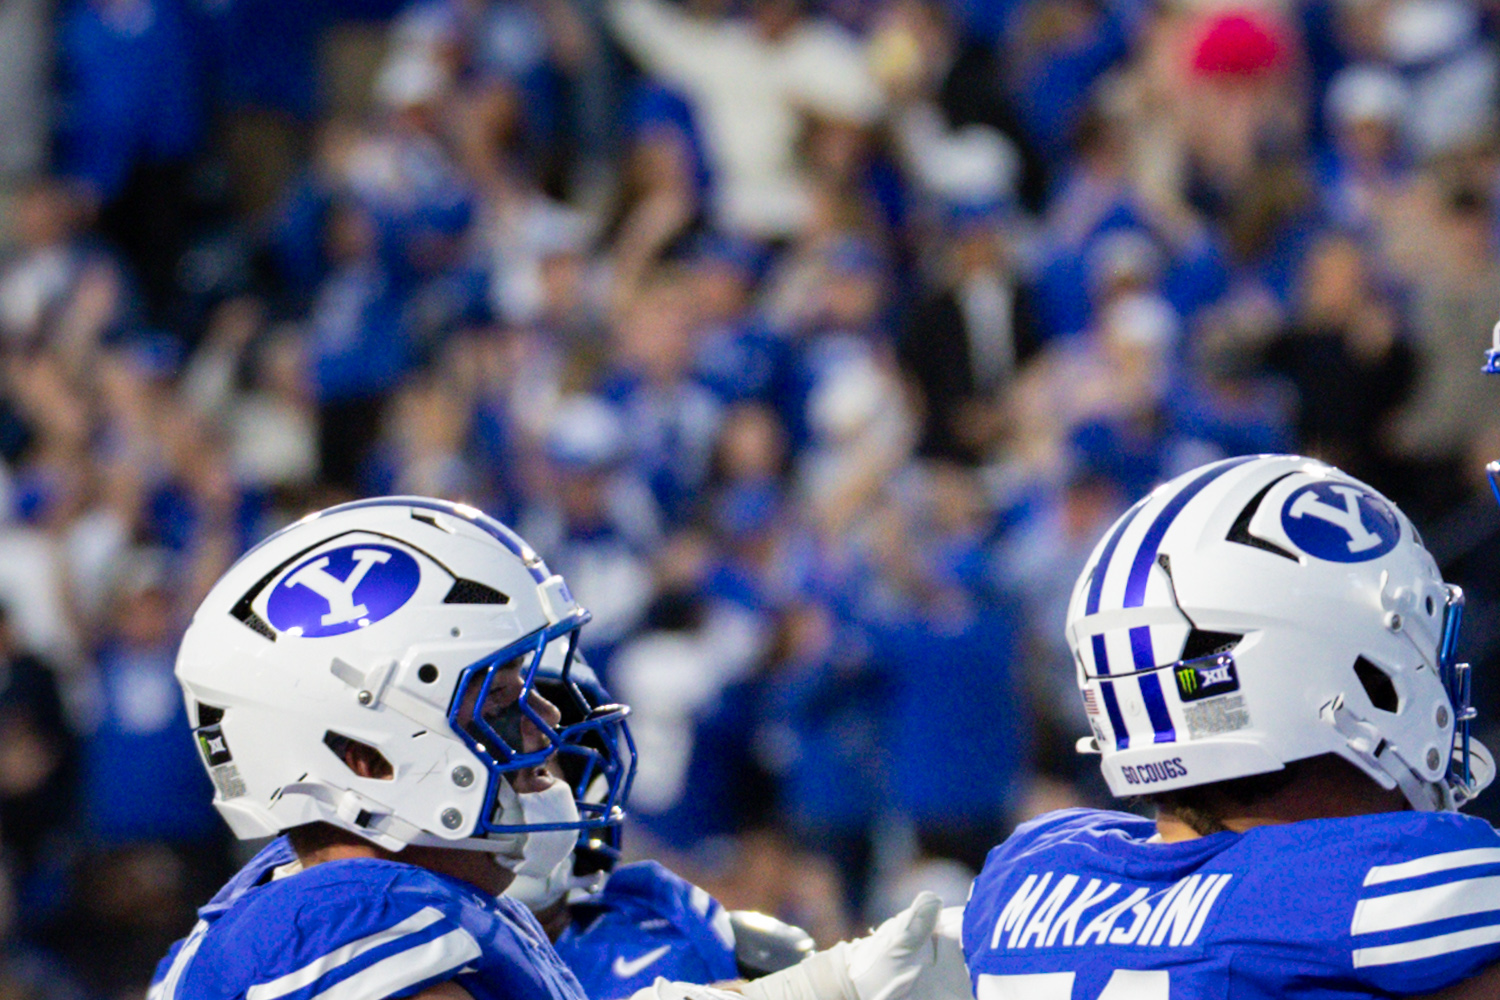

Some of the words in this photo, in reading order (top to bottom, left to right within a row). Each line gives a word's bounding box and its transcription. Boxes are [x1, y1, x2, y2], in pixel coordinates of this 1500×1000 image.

[1289, 485, 1383, 553] Y
[285, 549, 391, 626] Y
[1121, 765, 1140, 784] GO
[1136, 757, 1188, 784] COUGS
[990, 871, 1233, 949] MAKASINI
